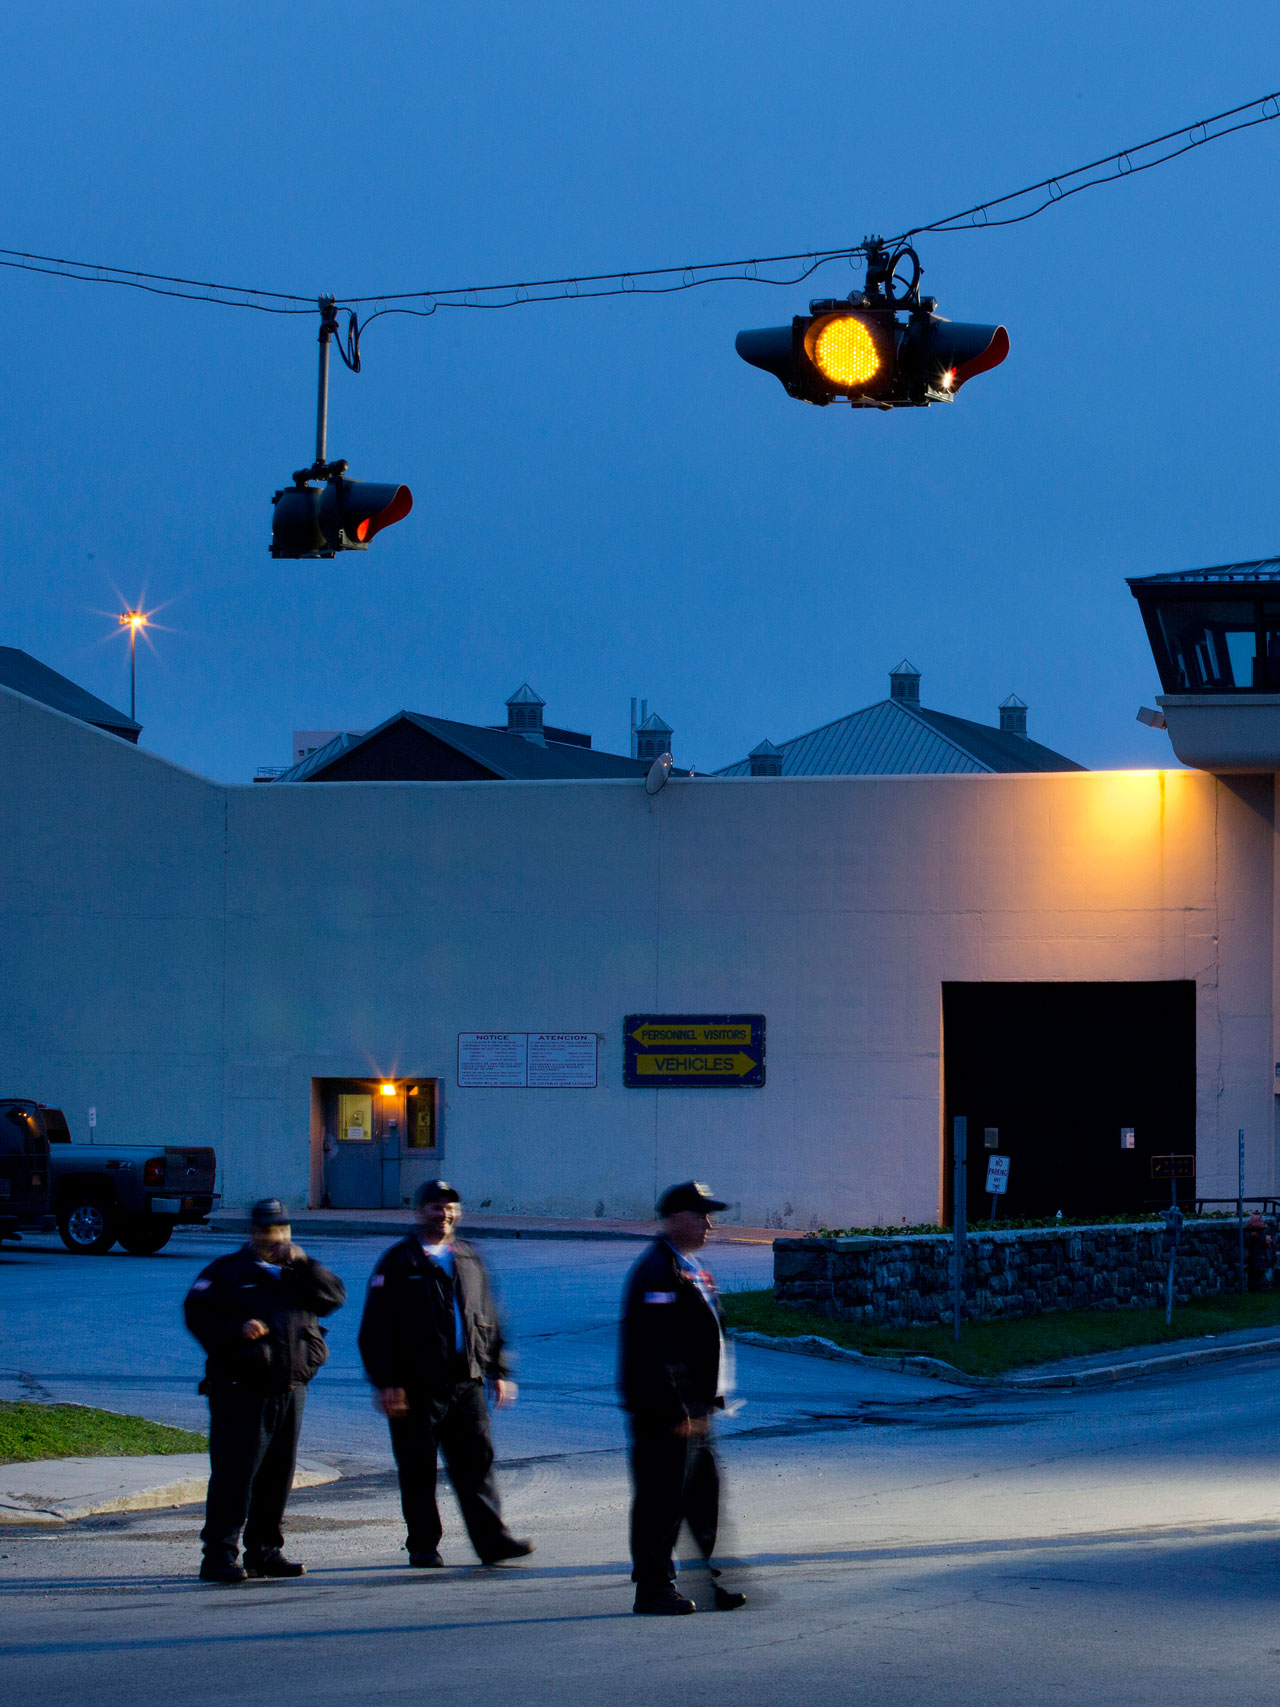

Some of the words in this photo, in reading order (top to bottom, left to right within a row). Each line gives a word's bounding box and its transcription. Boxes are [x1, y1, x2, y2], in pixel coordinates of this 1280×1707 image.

[641, 1029, 698, 1041] PERSONNEL
[703, 1029, 747, 1041] VISITORS
[654, 1057, 735, 1072] VEHICLES
